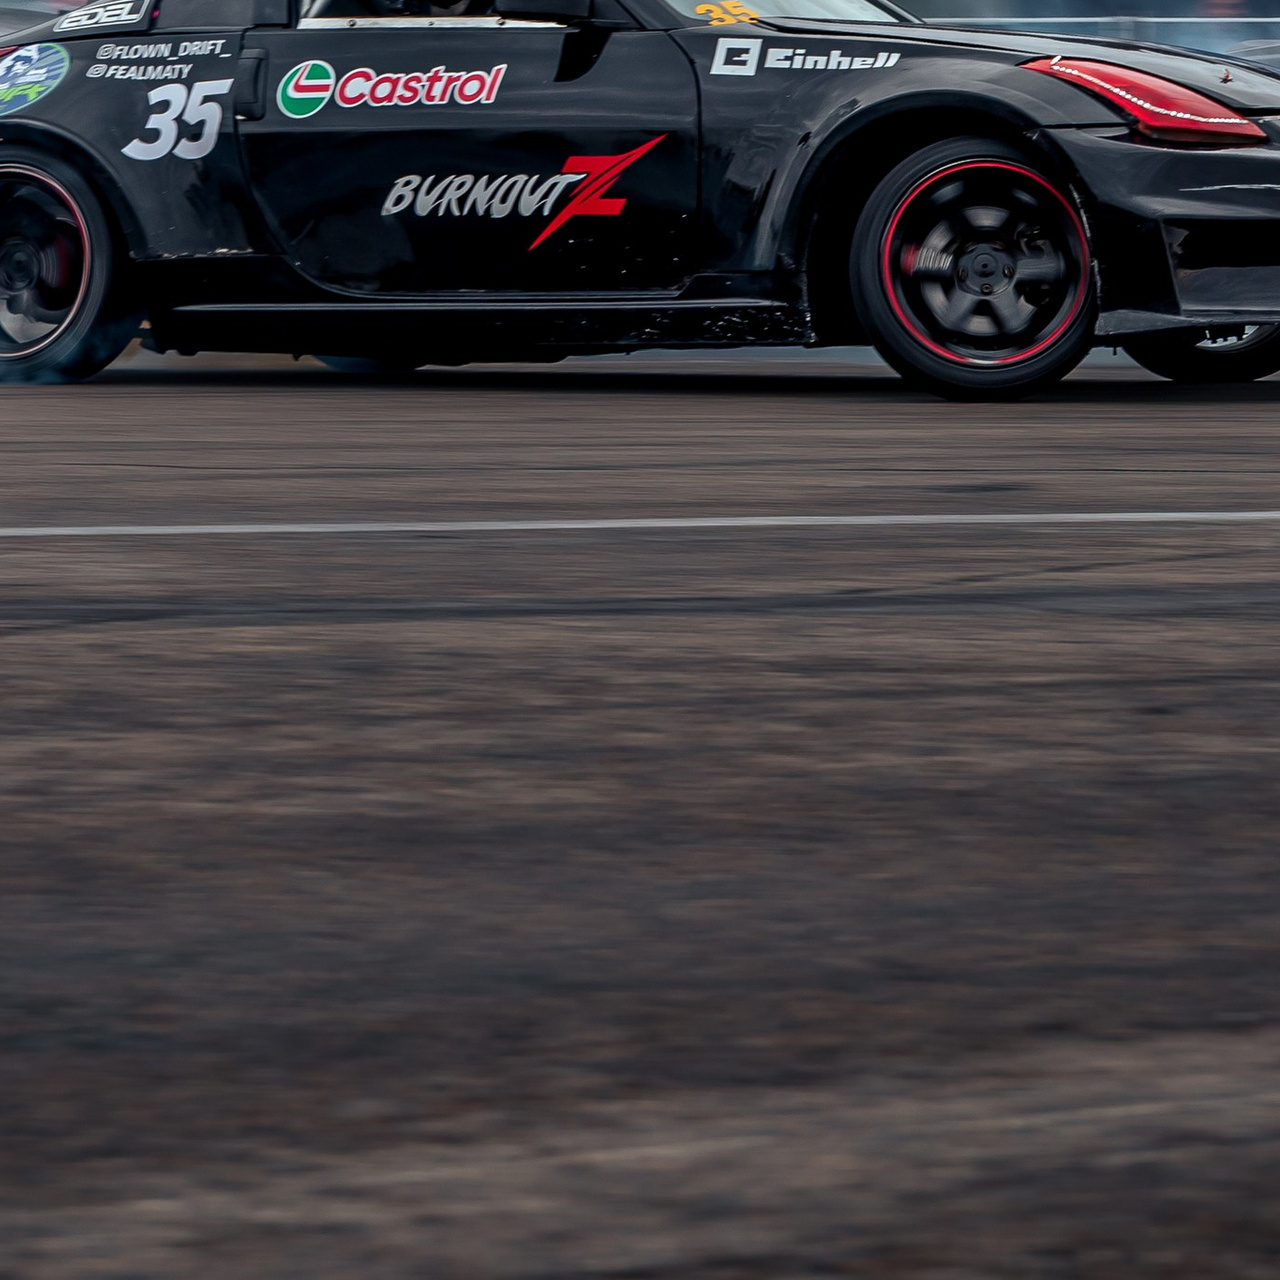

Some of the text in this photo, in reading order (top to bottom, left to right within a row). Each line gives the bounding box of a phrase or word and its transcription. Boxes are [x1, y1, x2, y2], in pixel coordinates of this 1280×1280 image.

[695, 0, 761, 26] 35
[96, 40, 232, 60] @FLOWN_DRIFT_
[764, 48, 902, 70] Einhell
[86, 64, 193, 80] @FEALMATY
[334, 64, 508, 108] Castrol
[121, 78, 235, 161] 35
[381, 174, 588, 218] BURNOUT
